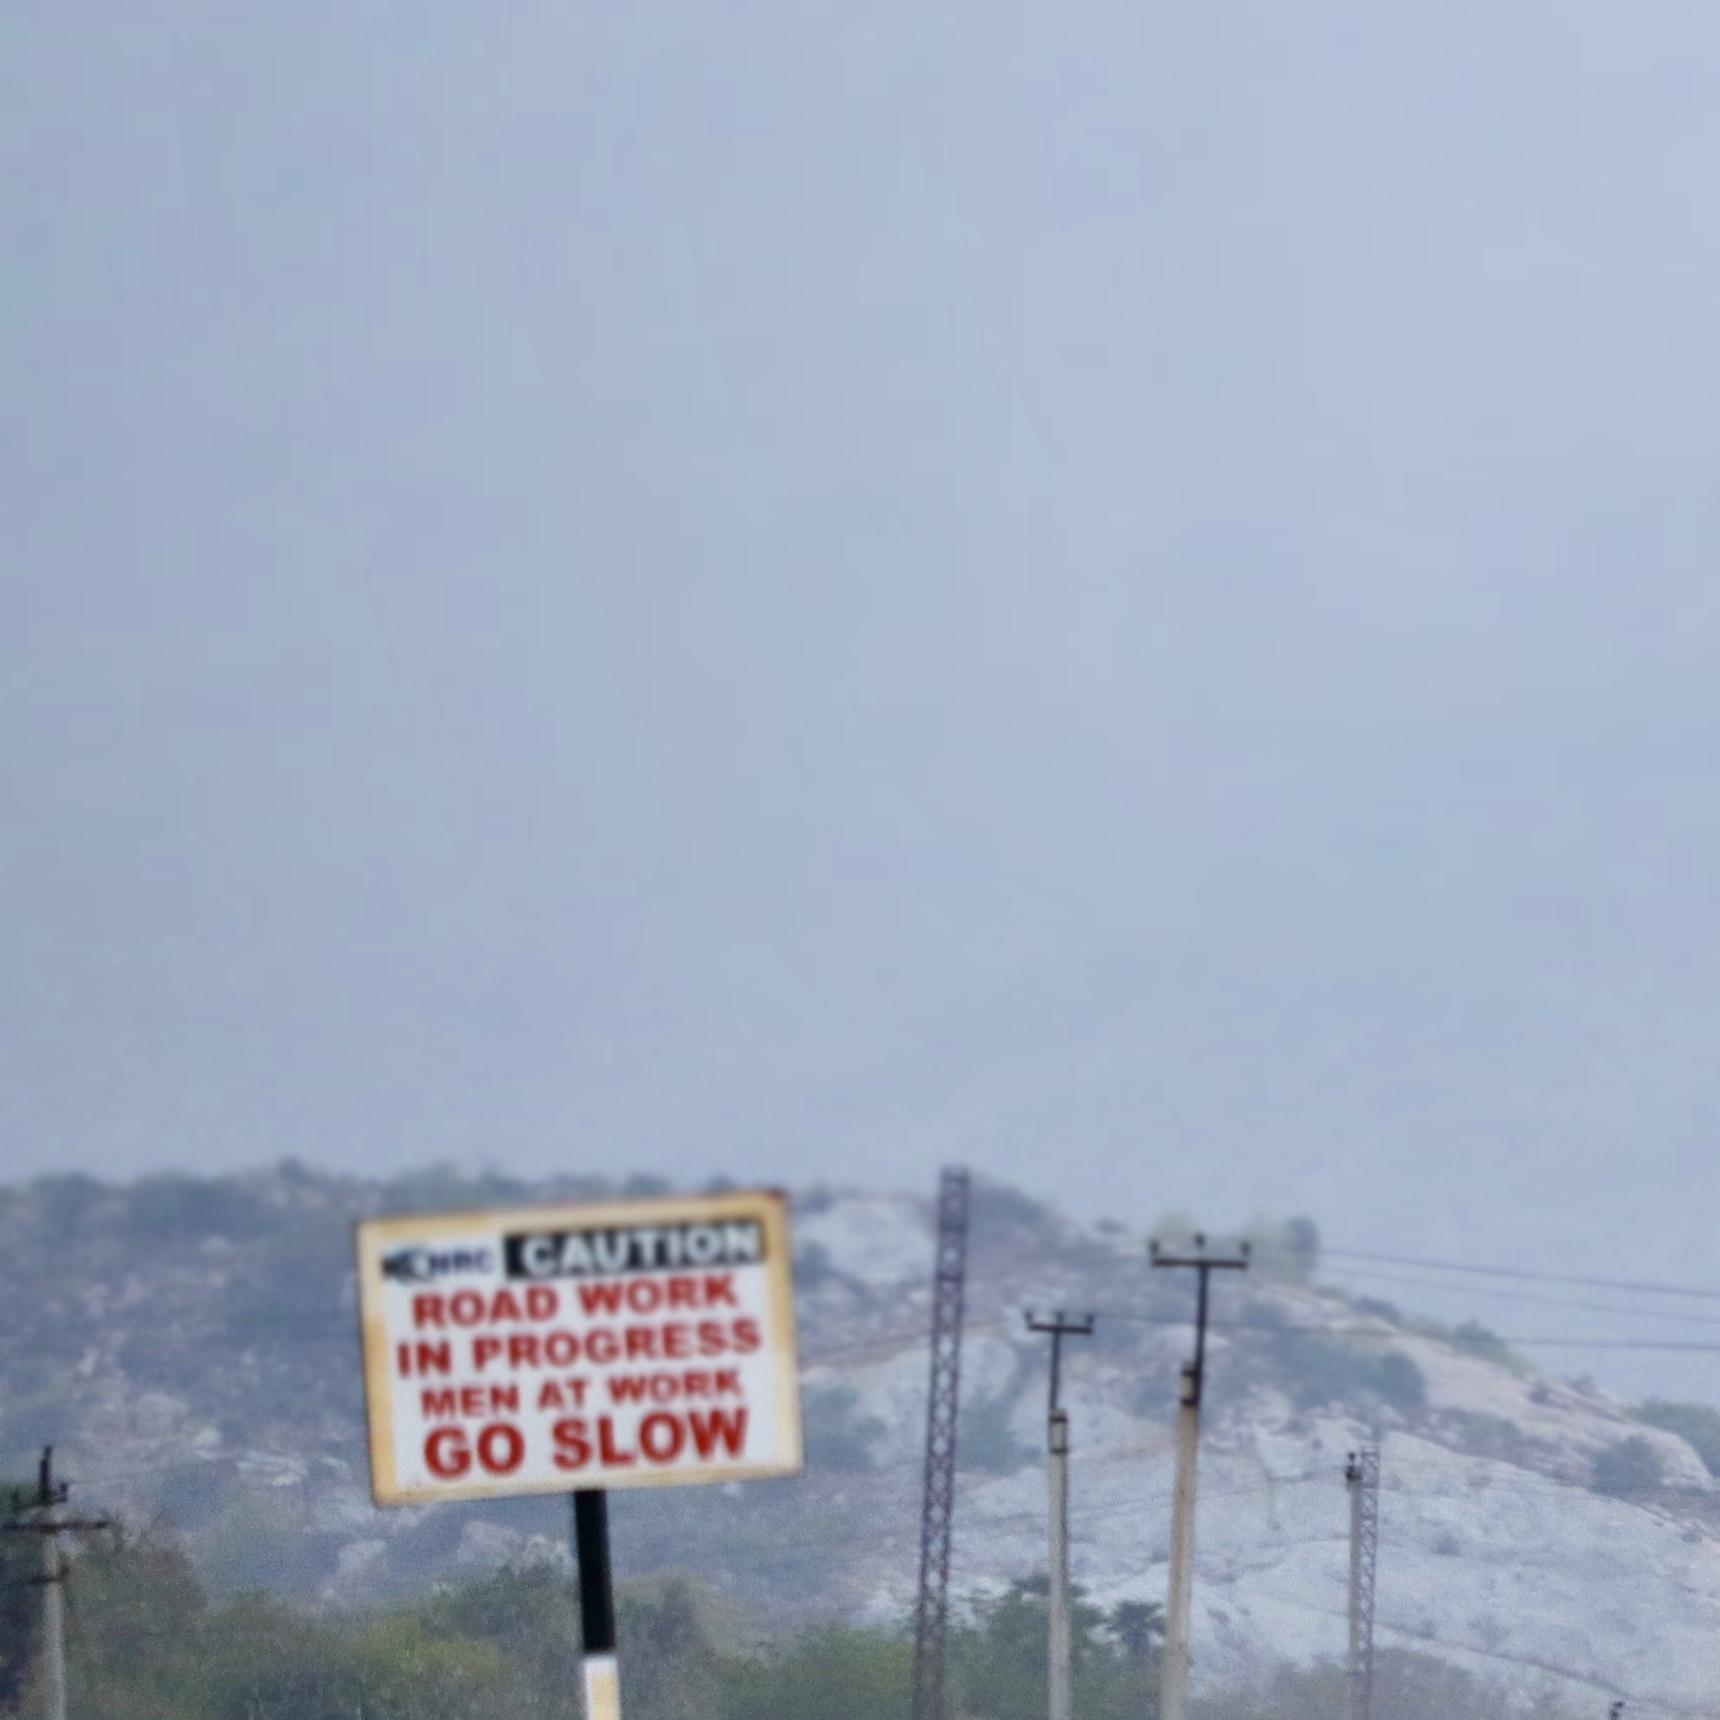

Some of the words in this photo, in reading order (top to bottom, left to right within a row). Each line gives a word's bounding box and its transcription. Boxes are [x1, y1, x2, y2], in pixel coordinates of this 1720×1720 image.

[523, 1224, 760, 1276] CAUTION
[412, 1286, 559, 1329] ROAD
[578, 1274, 739, 1315] WORK
[397, 1340, 451, 1377] IN
[472, 1318, 762, 1371] PROGRESS
[420, 1383, 520, 1419] MEN
[537, 1378, 589, 1411] AT
[607, 1369, 741, 1406] WORK
[423, 1421, 525, 1480] GO
[552, 1406, 748, 1470] SLOW
